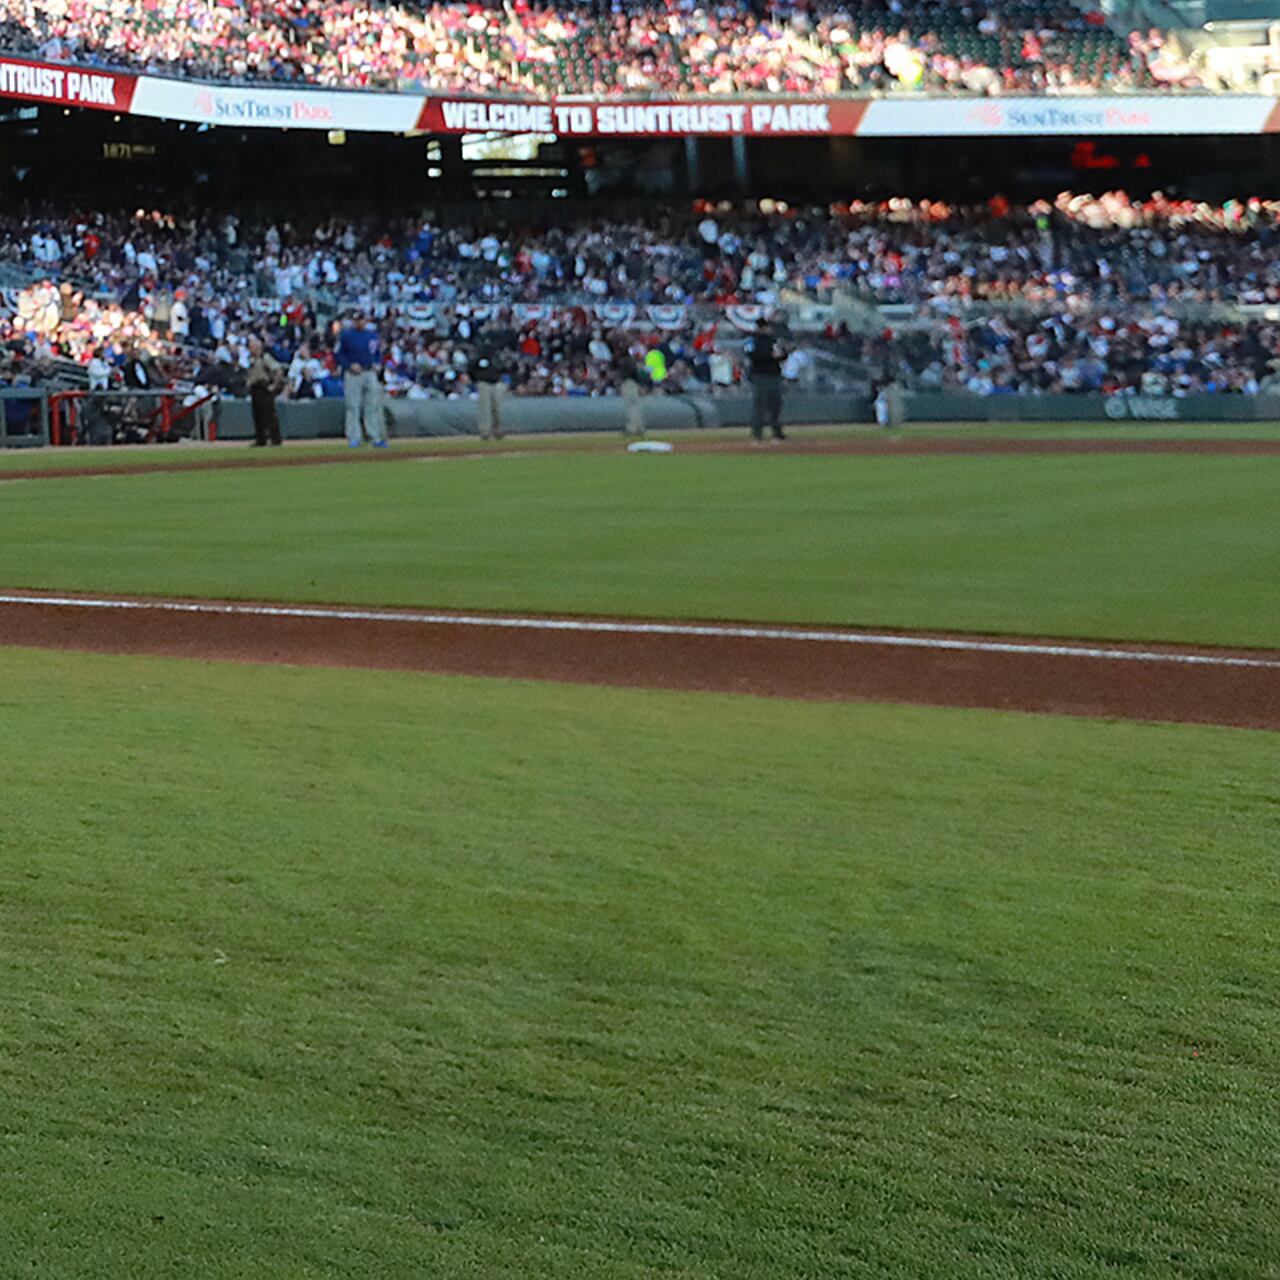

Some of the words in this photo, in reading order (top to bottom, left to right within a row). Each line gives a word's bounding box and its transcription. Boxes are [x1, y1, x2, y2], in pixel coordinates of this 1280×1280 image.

[67, 72, 116, 104] PARK
[441, 100, 554, 133] WELCOME
[554, 106, 593, 133] TO
[596, 105, 746, 133] SUNTRUST
[751, 104, 831, 132] PARK
